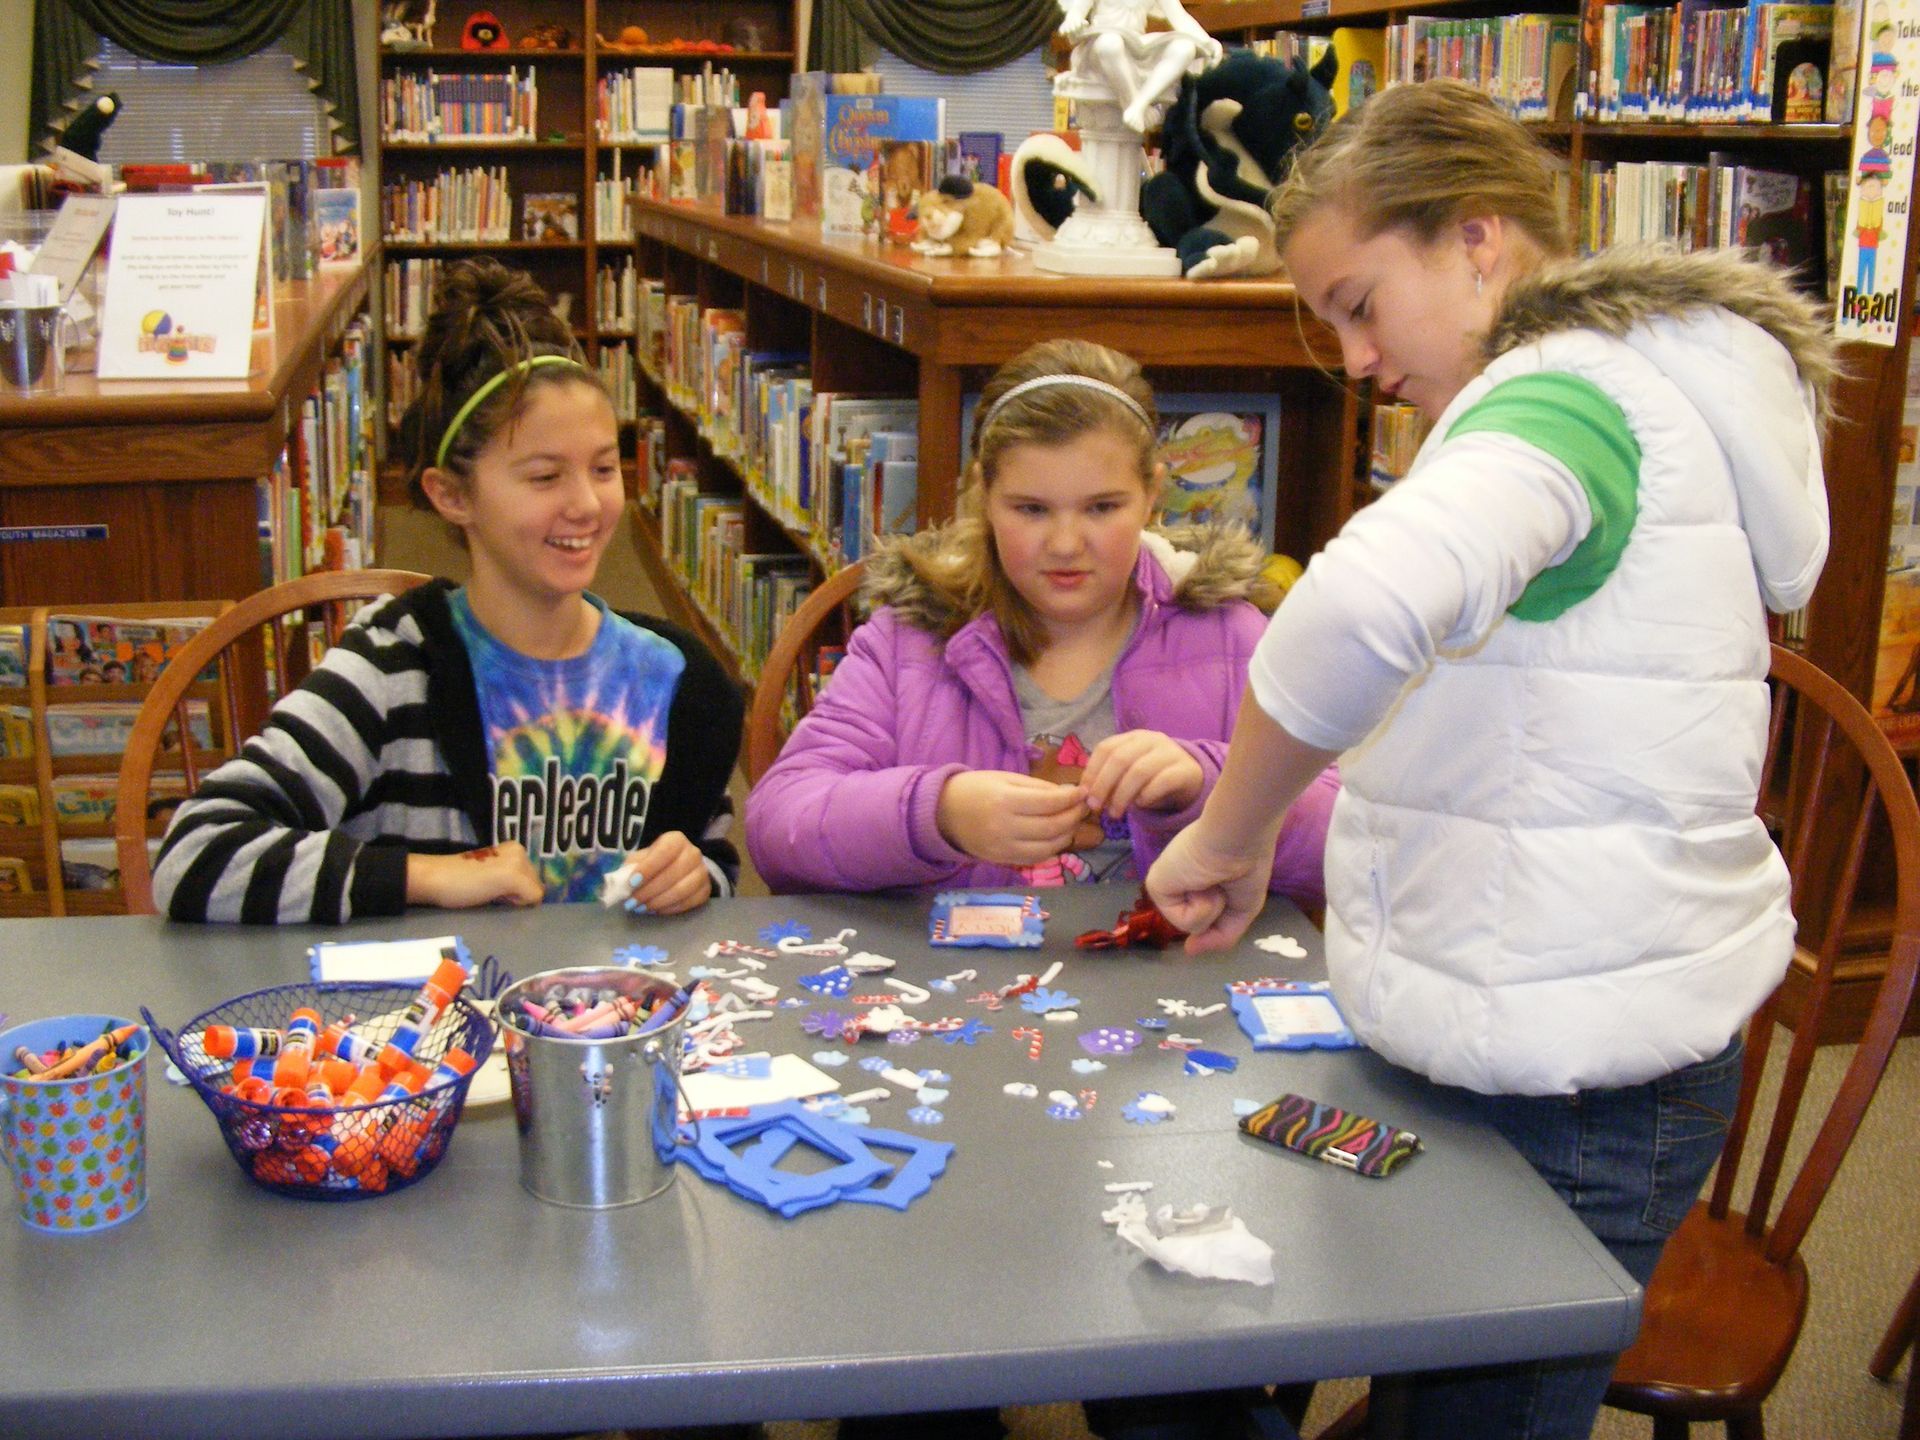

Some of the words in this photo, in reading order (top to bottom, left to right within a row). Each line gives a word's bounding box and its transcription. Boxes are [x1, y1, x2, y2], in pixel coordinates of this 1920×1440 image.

[1897, 19, 1920, 39] Take
[1901, 80, 1920, 98] the
[167, 207, 183, 218] Toy
[1887, 196, 1908, 215] and
[1842, 285, 1900, 324] Read
[0, 530, 29, 540] OUTH
[32, 528, 88, 539] MAGAZINES
[487, 755, 652, 858] erleade
